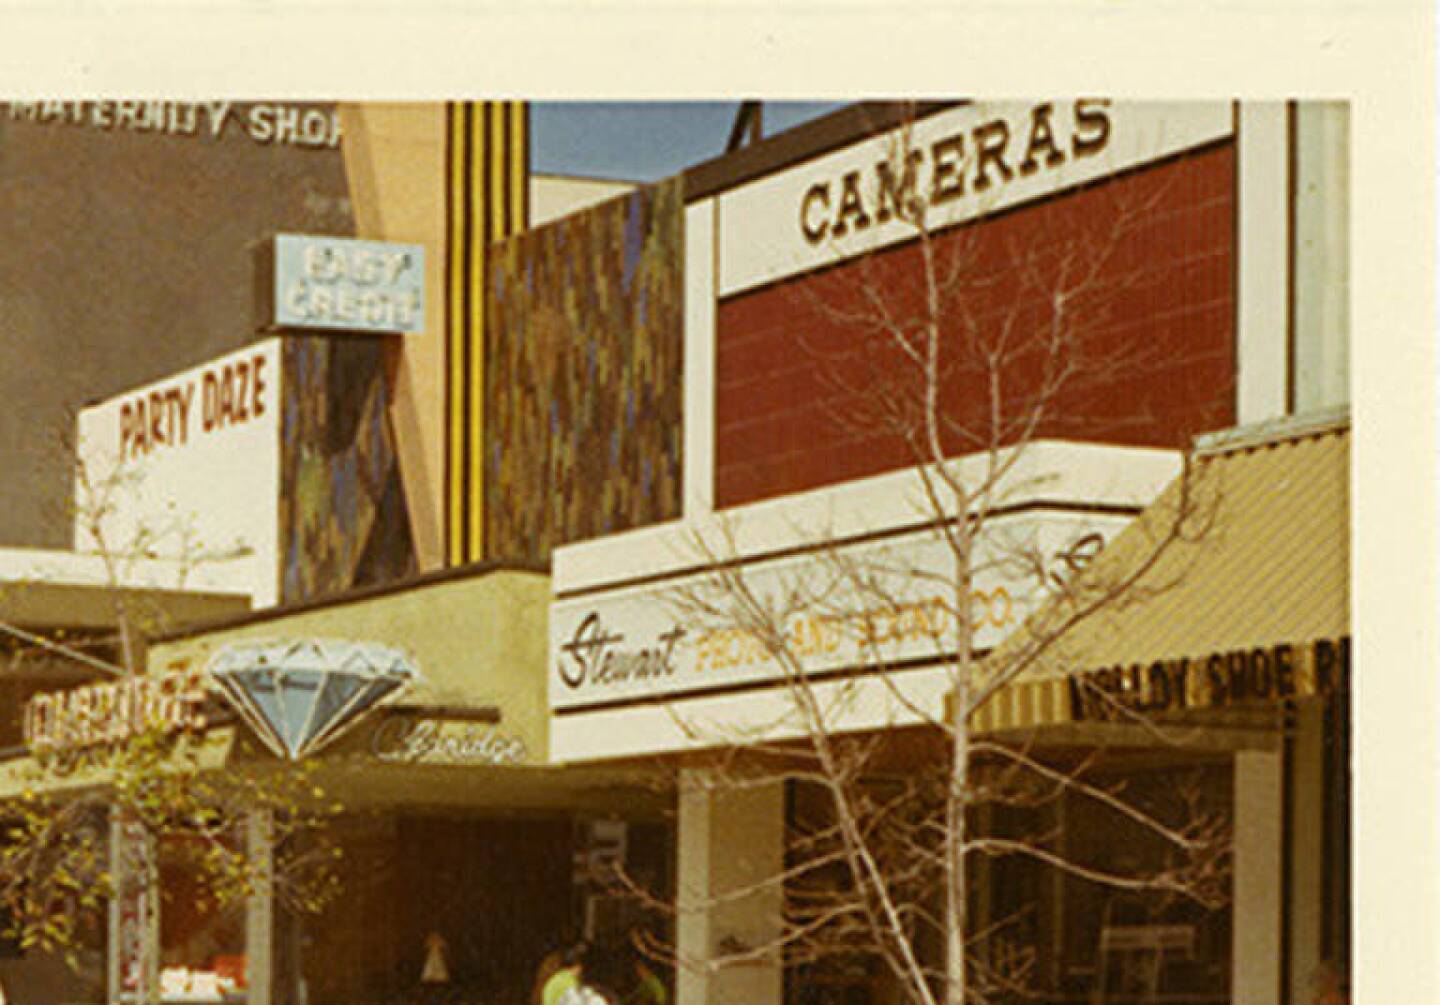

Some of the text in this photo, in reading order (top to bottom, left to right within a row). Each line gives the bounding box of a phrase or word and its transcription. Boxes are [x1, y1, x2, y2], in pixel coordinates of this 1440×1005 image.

[800, 98, 1114, 244] CAMERAS
[119, 354, 266, 466] PARTY DAZE
[557, 611, 689, 689] Stewart
[1208, 644, 1293, 703] SHOE
